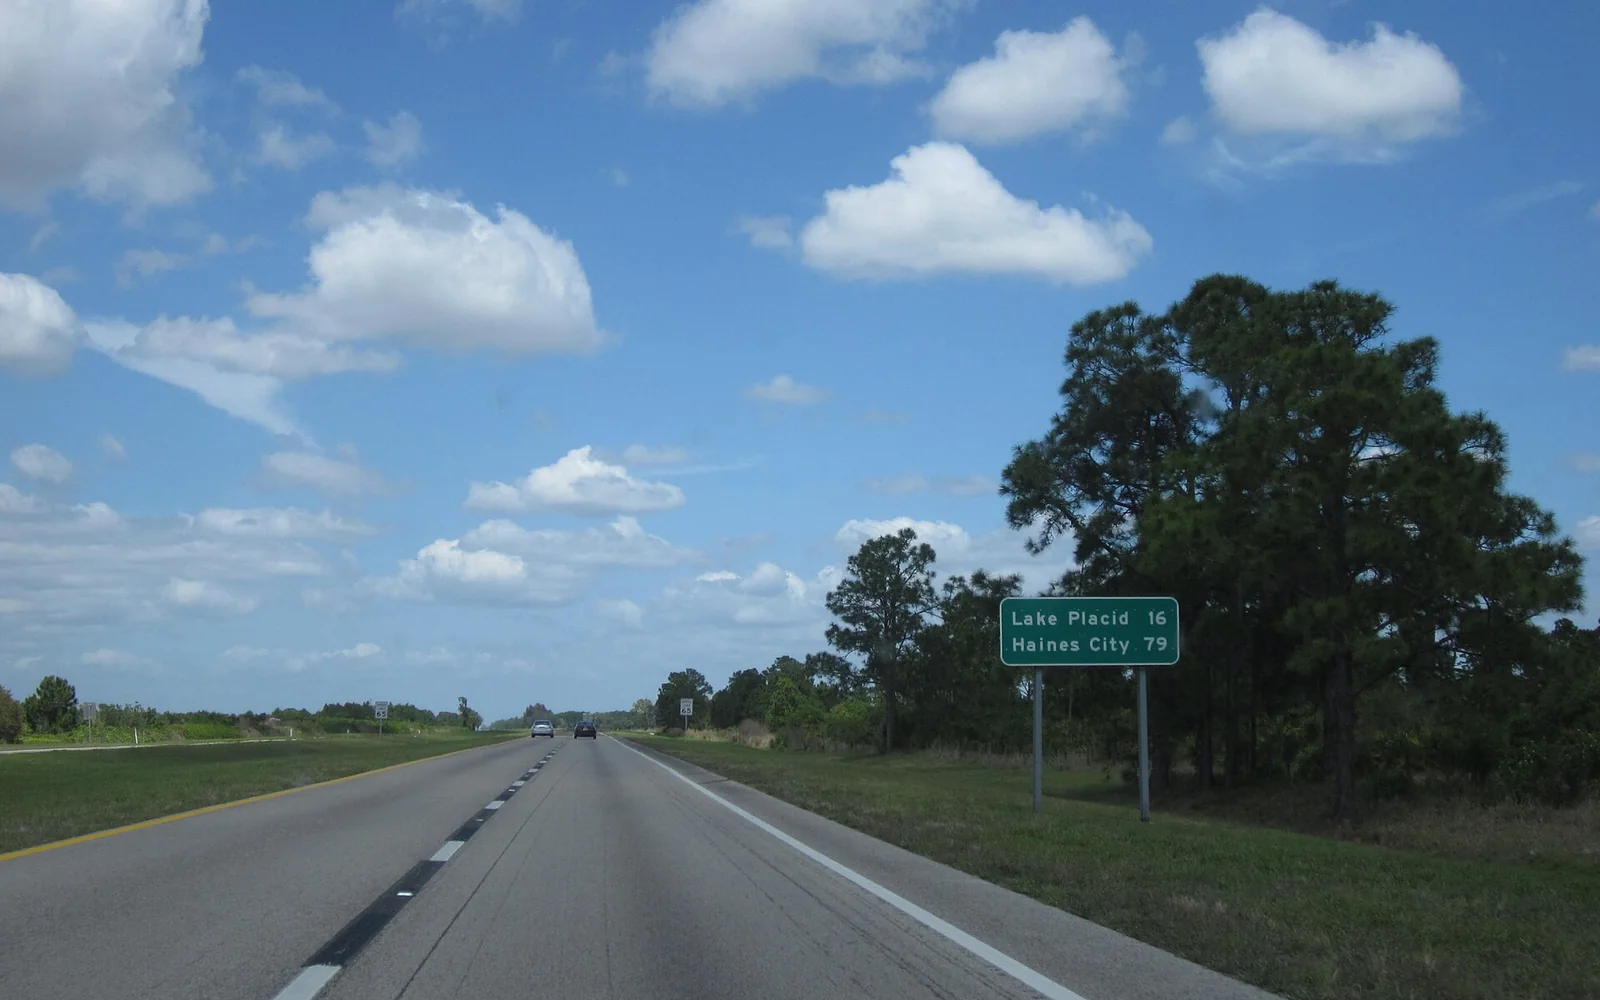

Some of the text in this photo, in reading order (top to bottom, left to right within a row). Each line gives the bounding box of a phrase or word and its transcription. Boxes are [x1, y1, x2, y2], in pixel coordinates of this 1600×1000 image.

[1012, 611, 1167, 626] Lake Placid 16
[1012, 636, 1167, 655] Haines City 79
